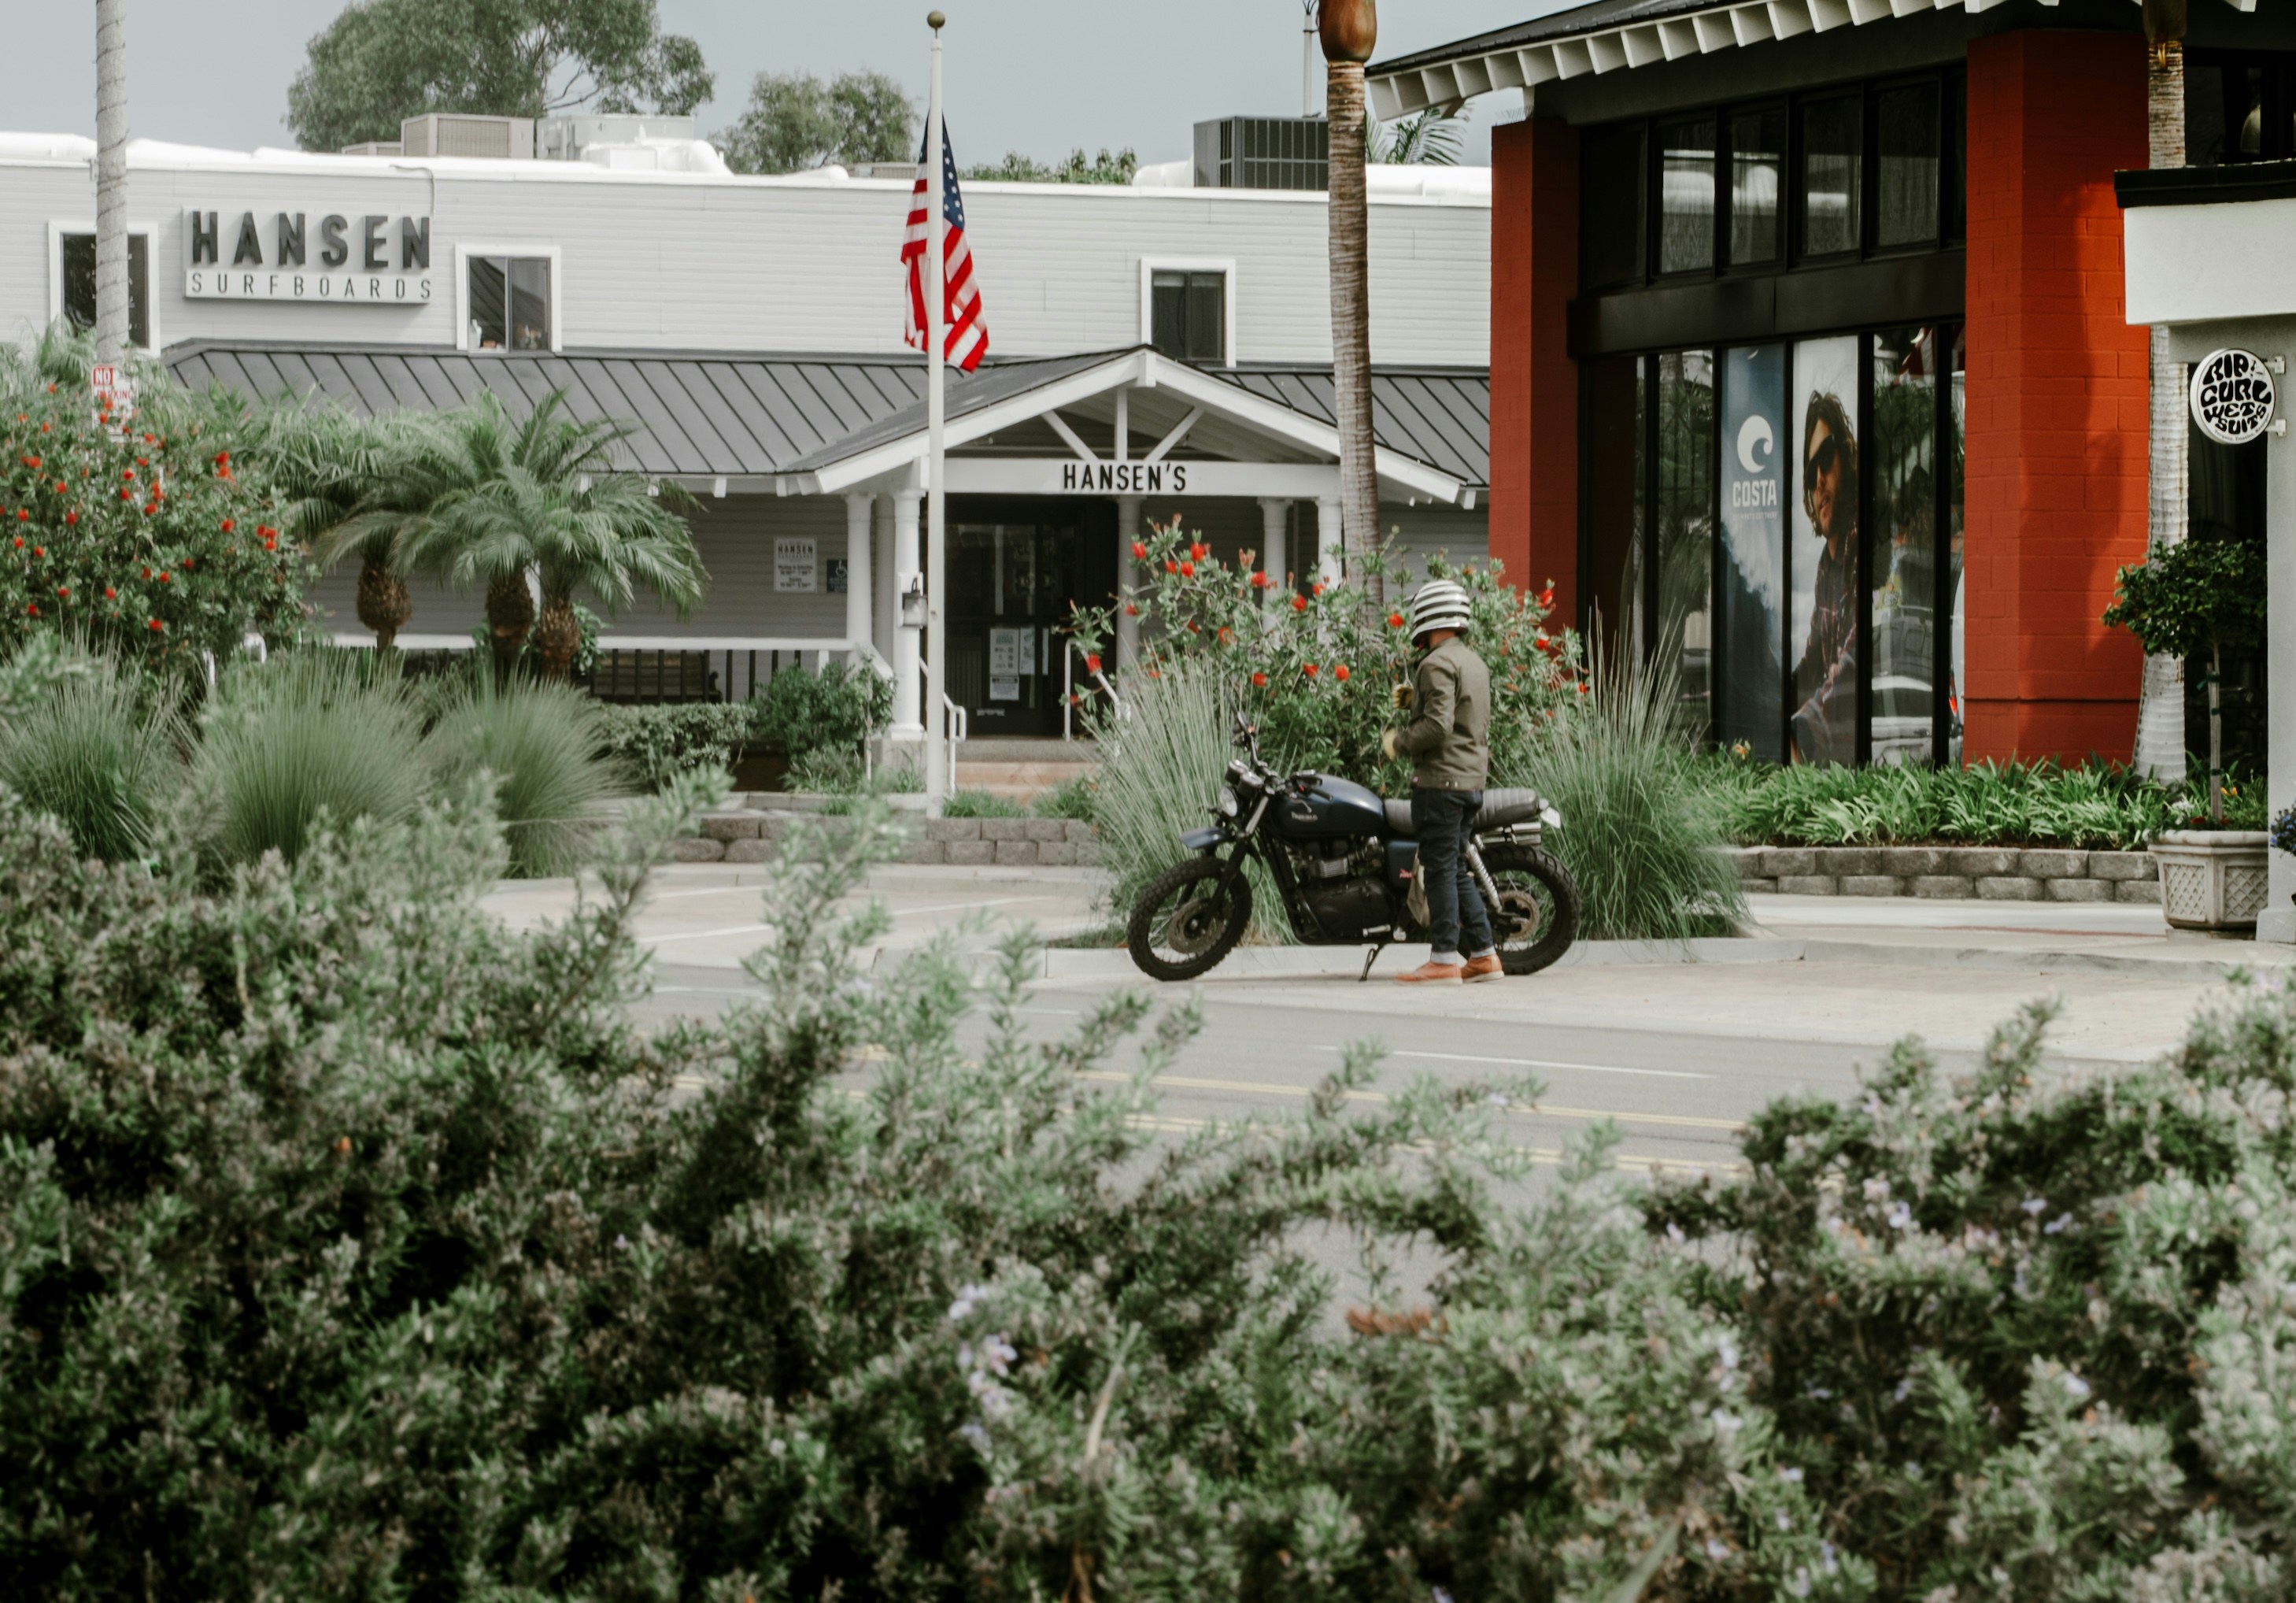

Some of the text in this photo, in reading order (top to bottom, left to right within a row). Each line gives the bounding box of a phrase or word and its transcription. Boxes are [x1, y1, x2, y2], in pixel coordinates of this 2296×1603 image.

[192, 211, 430, 268] HANSEN
[191, 273, 431, 299] SURFBOARDS
[95, 368, 112, 385] NO
[2202, 354, 2249, 384] RIP
[2201, 379, 2272, 408] CURL
[1064, 463, 1186, 491] HANSEN'S
[1732, 479, 1777, 508] COSTA
